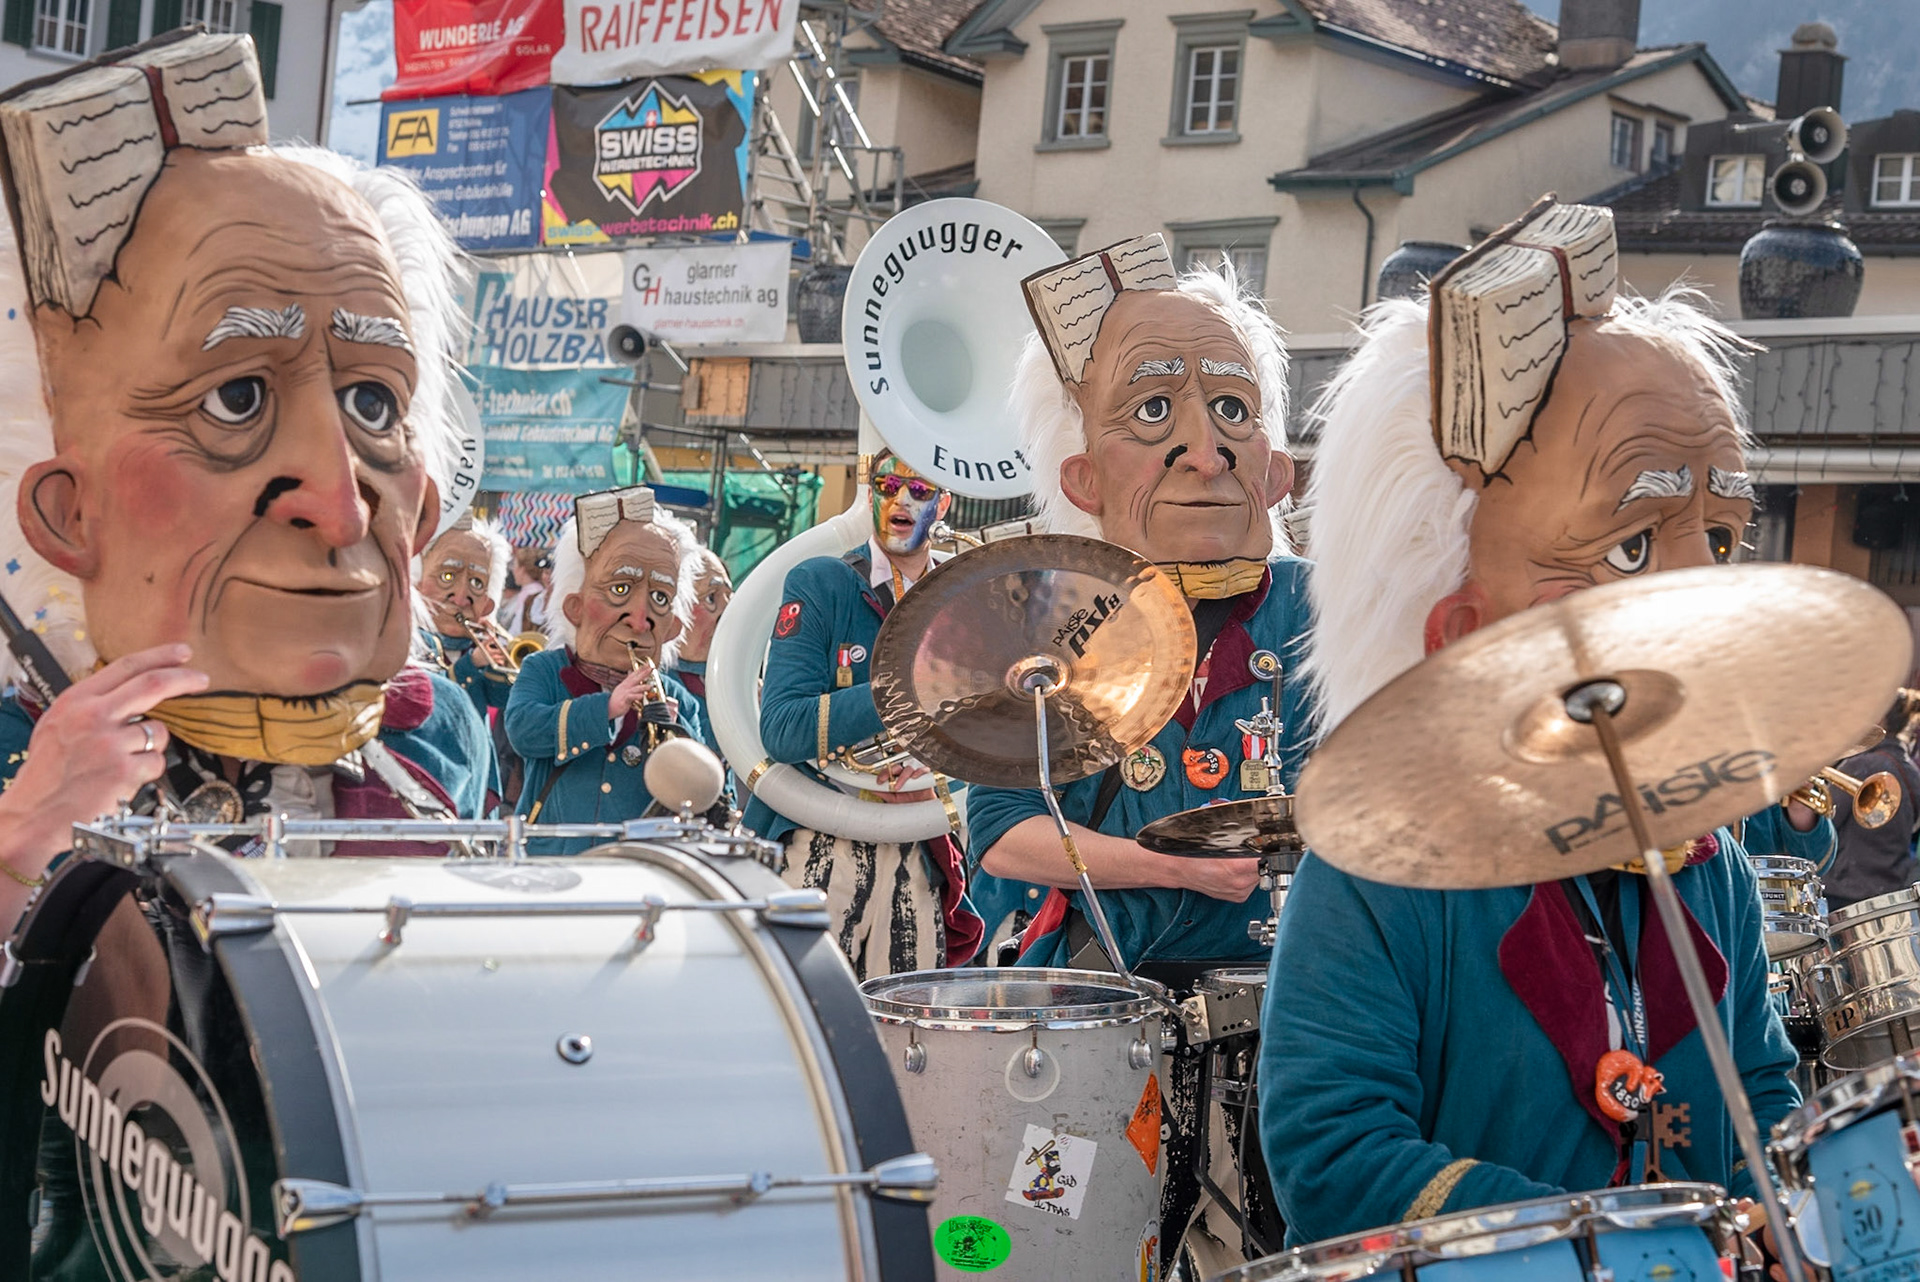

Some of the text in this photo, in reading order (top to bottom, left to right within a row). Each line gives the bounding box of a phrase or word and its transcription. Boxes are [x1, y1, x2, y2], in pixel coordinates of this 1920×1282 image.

[420, 15, 528, 51] WUNDERLE AG
[581, 0, 782, 53] RAIFFEISEN
[515, 44, 552, 57] SOLAR
[391, 115, 434, 151] FA
[601, 124, 698, 159] SWISS
[510, 208, 532, 236] AG
[687, 261, 738, 284] glarner
[487, 294, 609, 330] HAUSER
[663, 285, 779, 308] haustechnik ag
[863, 221, 1024, 396] sunneguugger
[488, 328, 610, 365] HOLZBA
[1614, 1080, 1641, 1110] 1850
[1853, 1203, 1884, 1238] 50
